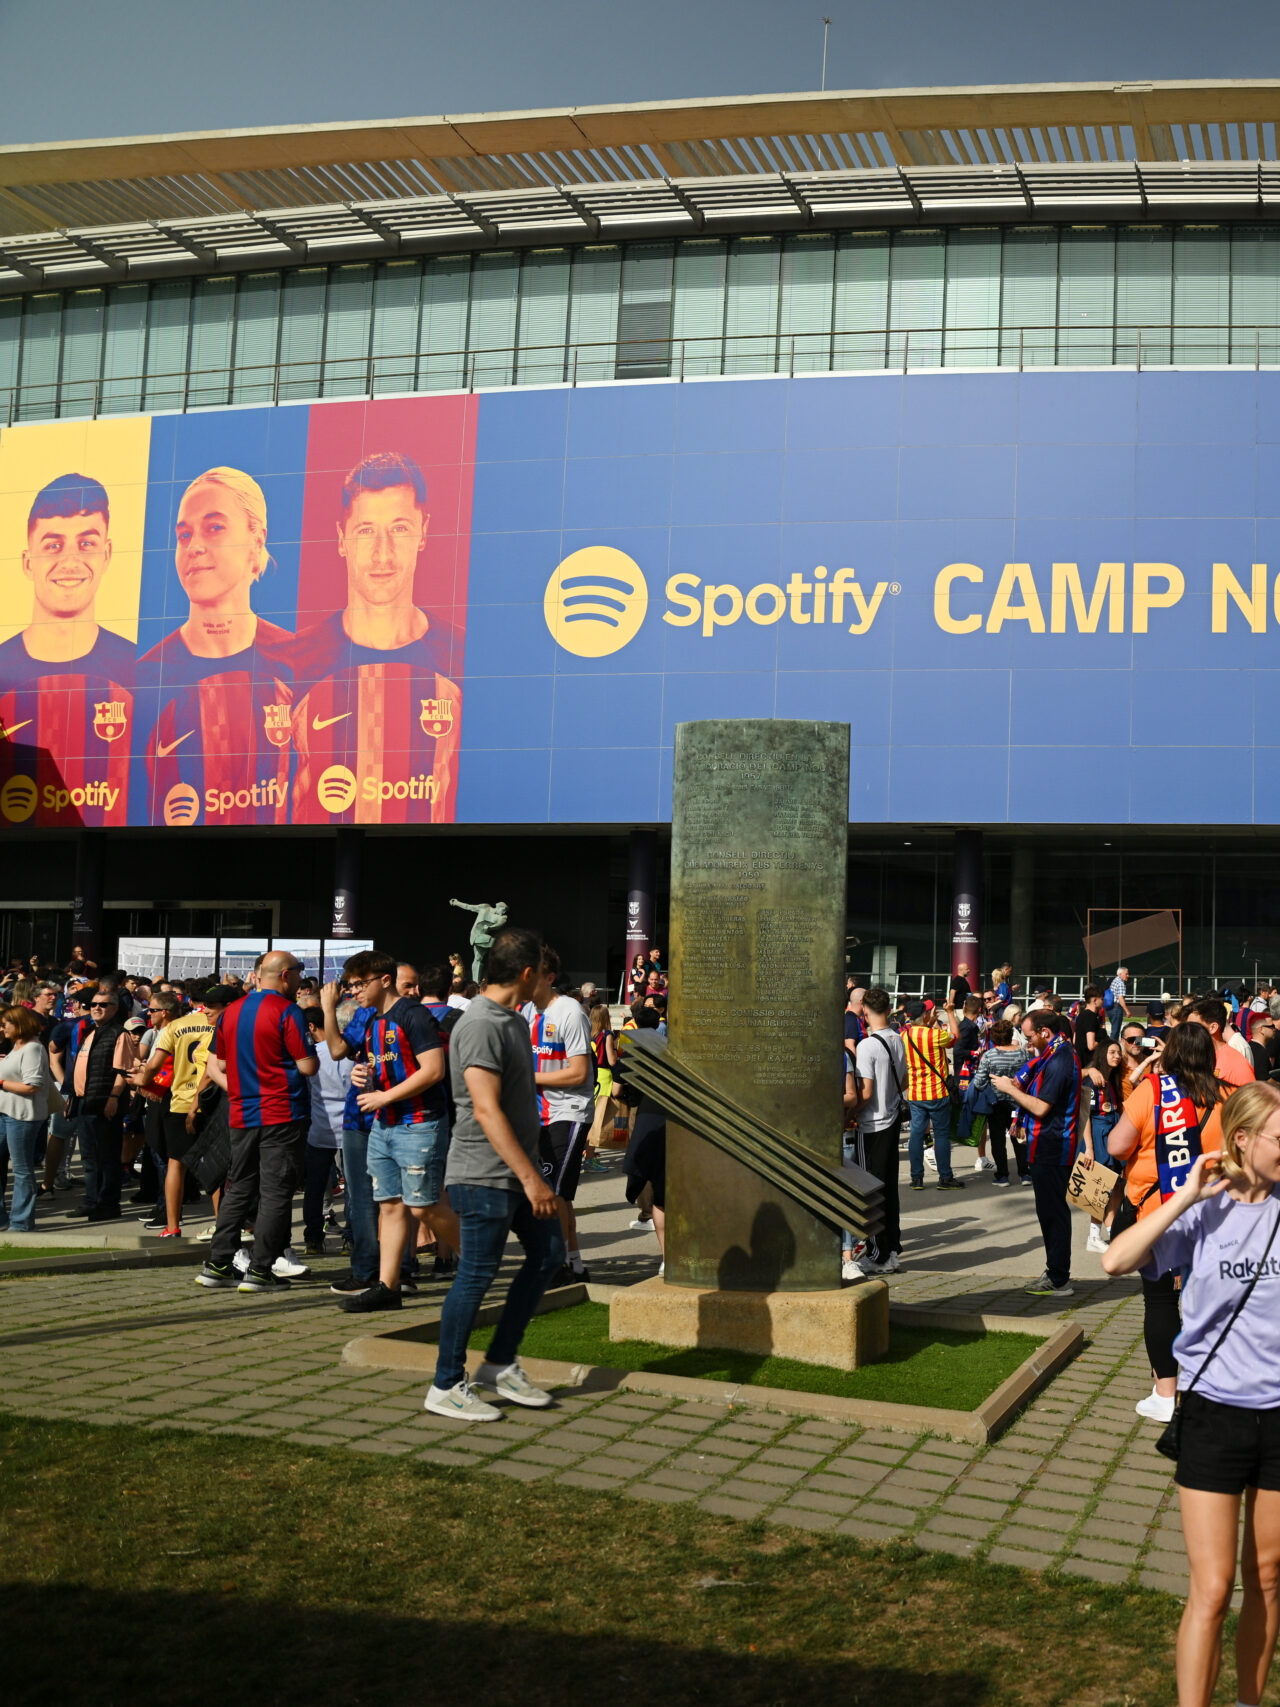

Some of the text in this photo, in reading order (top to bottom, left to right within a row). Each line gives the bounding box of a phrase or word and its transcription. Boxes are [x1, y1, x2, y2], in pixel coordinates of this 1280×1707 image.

[934, 562, 1186, 635] CAMP
[43, 780, 120, 813] Spotify
[205, 777, 289, 815] Spotify
[362, 773, 441, 804] Spotify
[1160, 1074, 1191, 1169] BARCE
